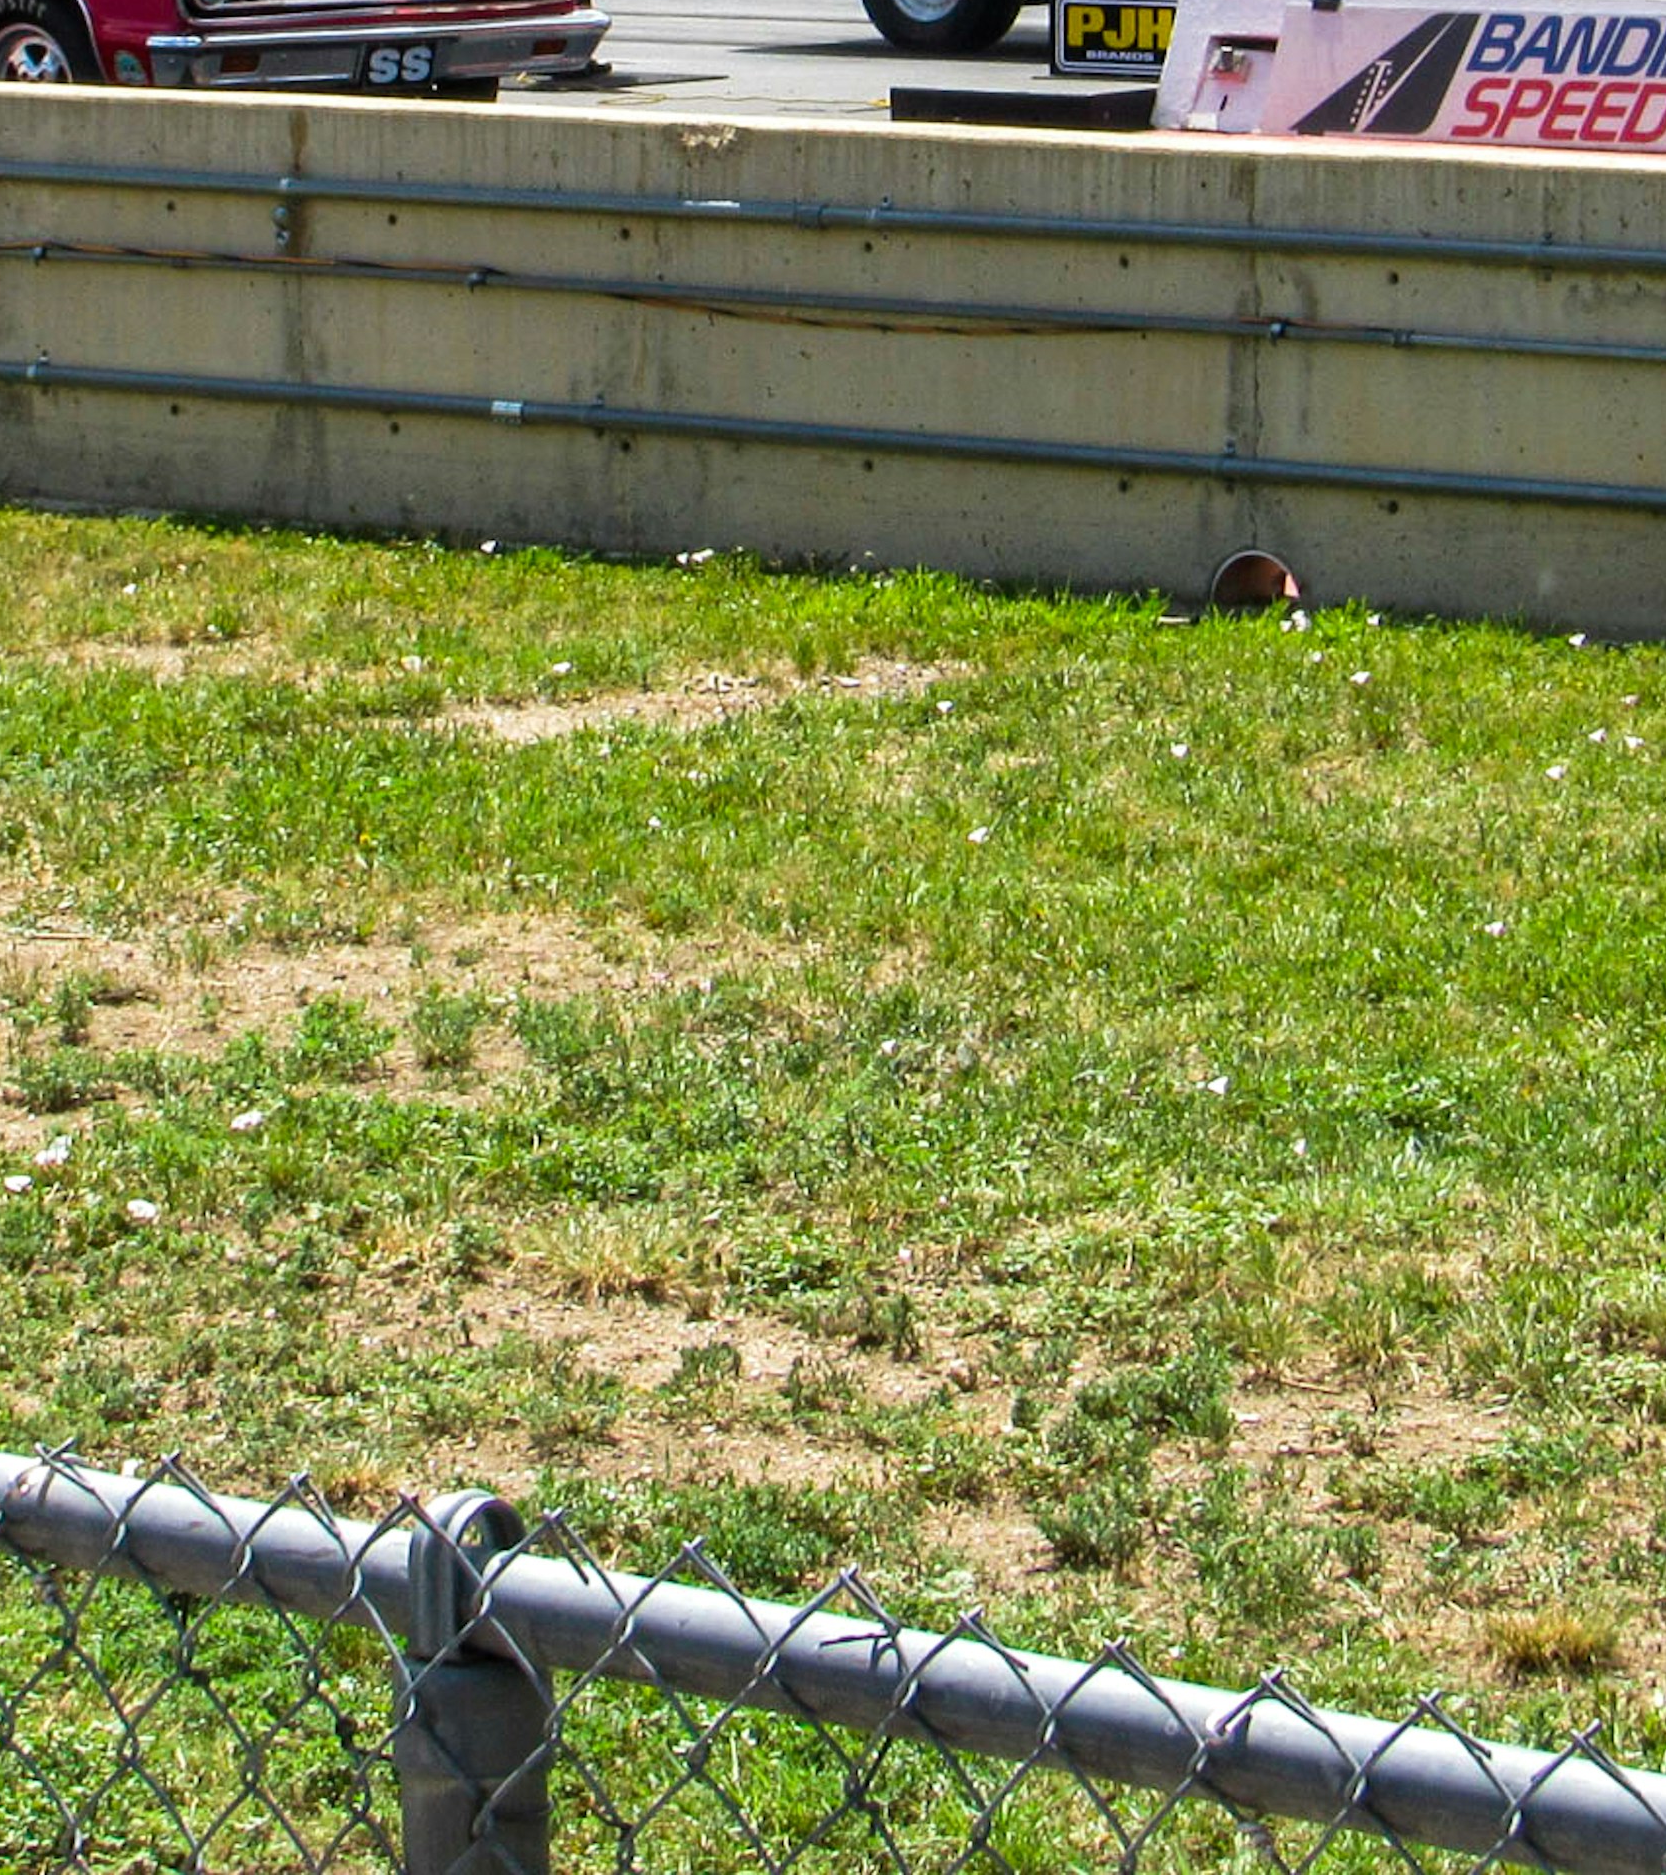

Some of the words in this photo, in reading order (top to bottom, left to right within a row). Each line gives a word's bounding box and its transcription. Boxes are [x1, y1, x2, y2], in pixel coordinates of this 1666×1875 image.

[1067, 5, 1173, 50] PJH
[369, 47, 431, 84] SS
[1086, 49, 1154, 62] BRANDS
